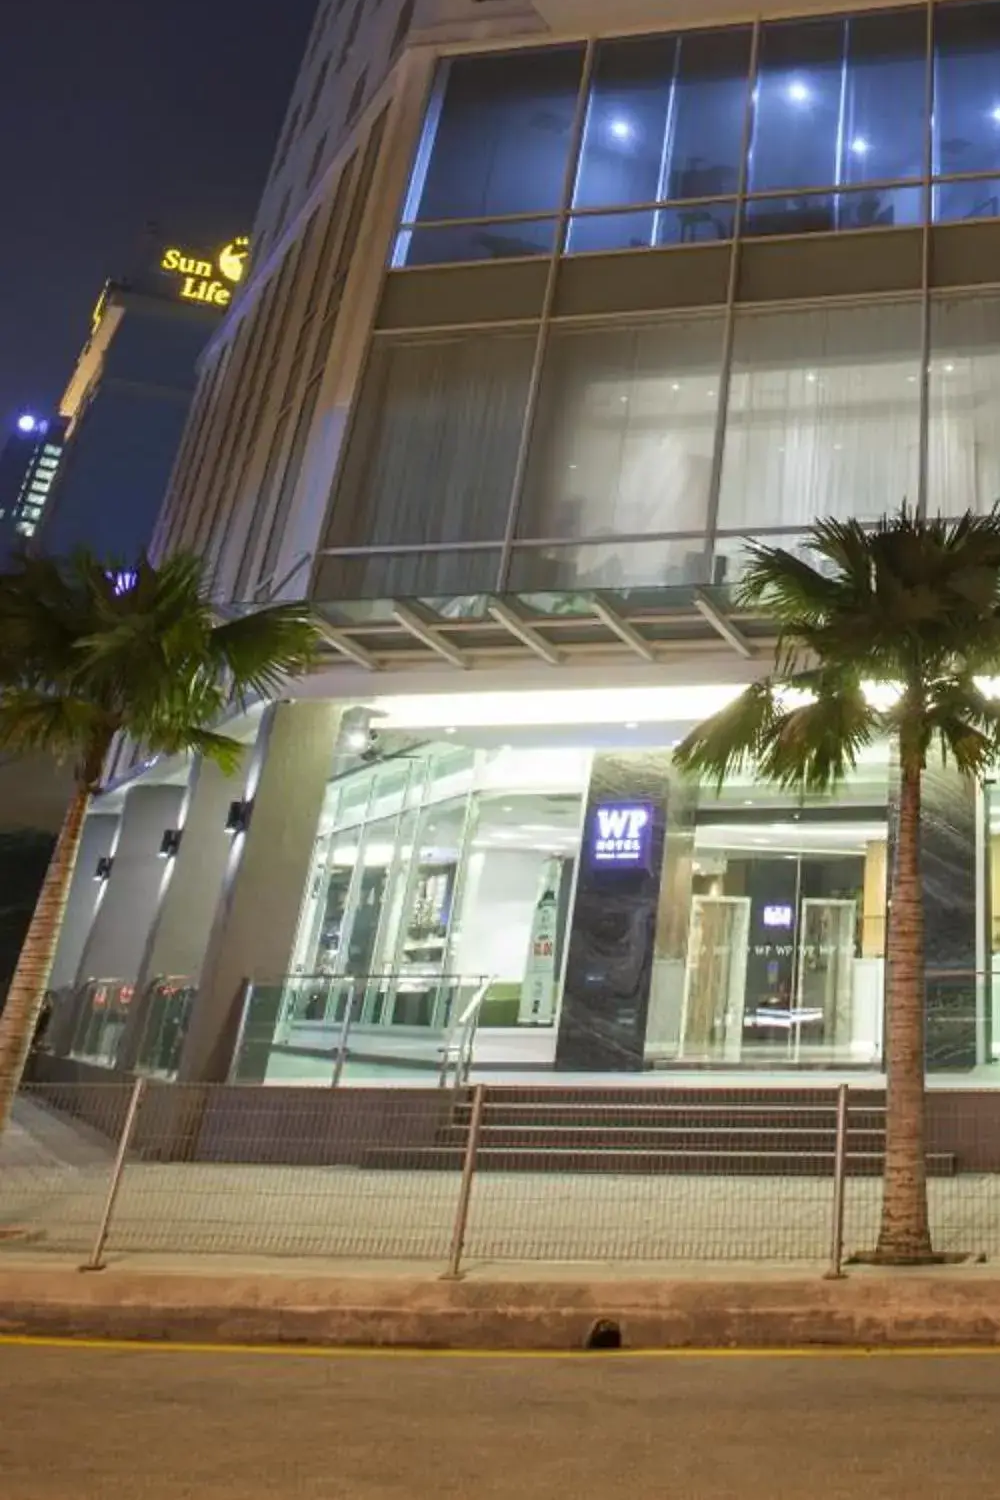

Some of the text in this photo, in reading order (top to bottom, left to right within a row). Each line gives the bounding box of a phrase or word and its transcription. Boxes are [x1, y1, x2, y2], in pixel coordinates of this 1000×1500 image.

[162, 249, 212, 277] Sun
[181, 277, 230, 305] Life
[597, 808, 648, 839] WP
